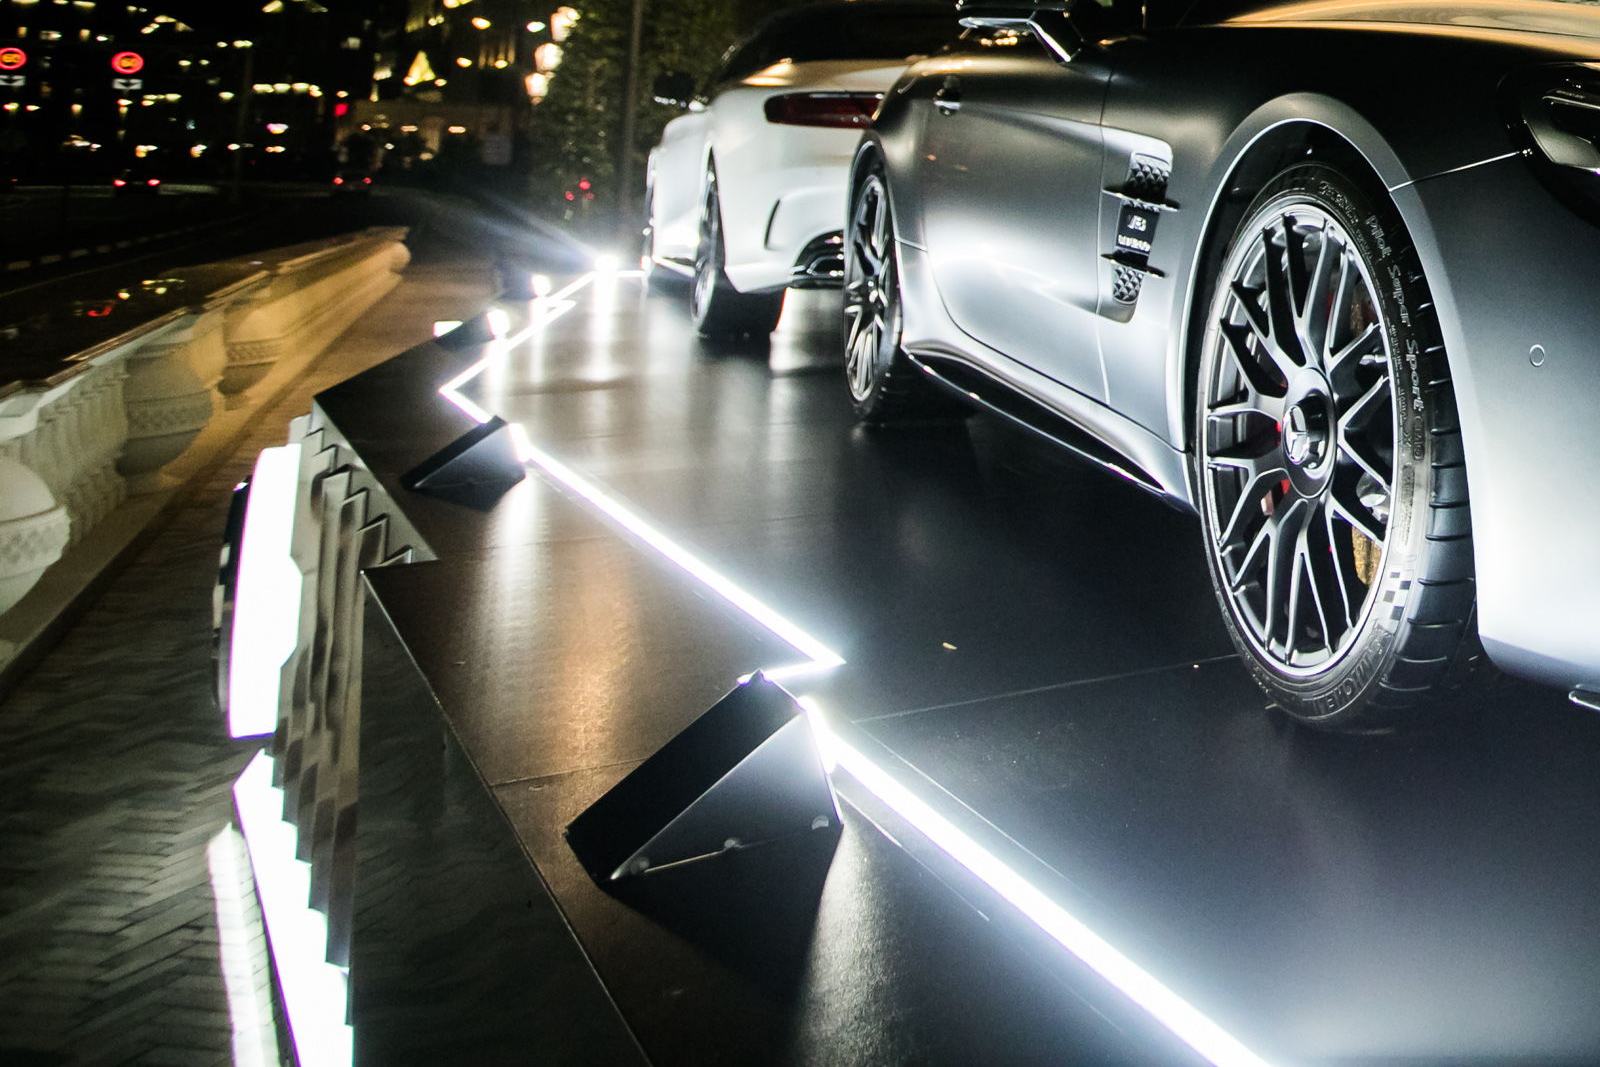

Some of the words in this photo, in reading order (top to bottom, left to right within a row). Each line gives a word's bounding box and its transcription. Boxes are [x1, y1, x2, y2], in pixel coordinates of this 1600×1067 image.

[1365, 214, 1392, 258] Pilot
[1387, 264, 1411, 327] Super
[1405, 339, 1425, 412] Sport
